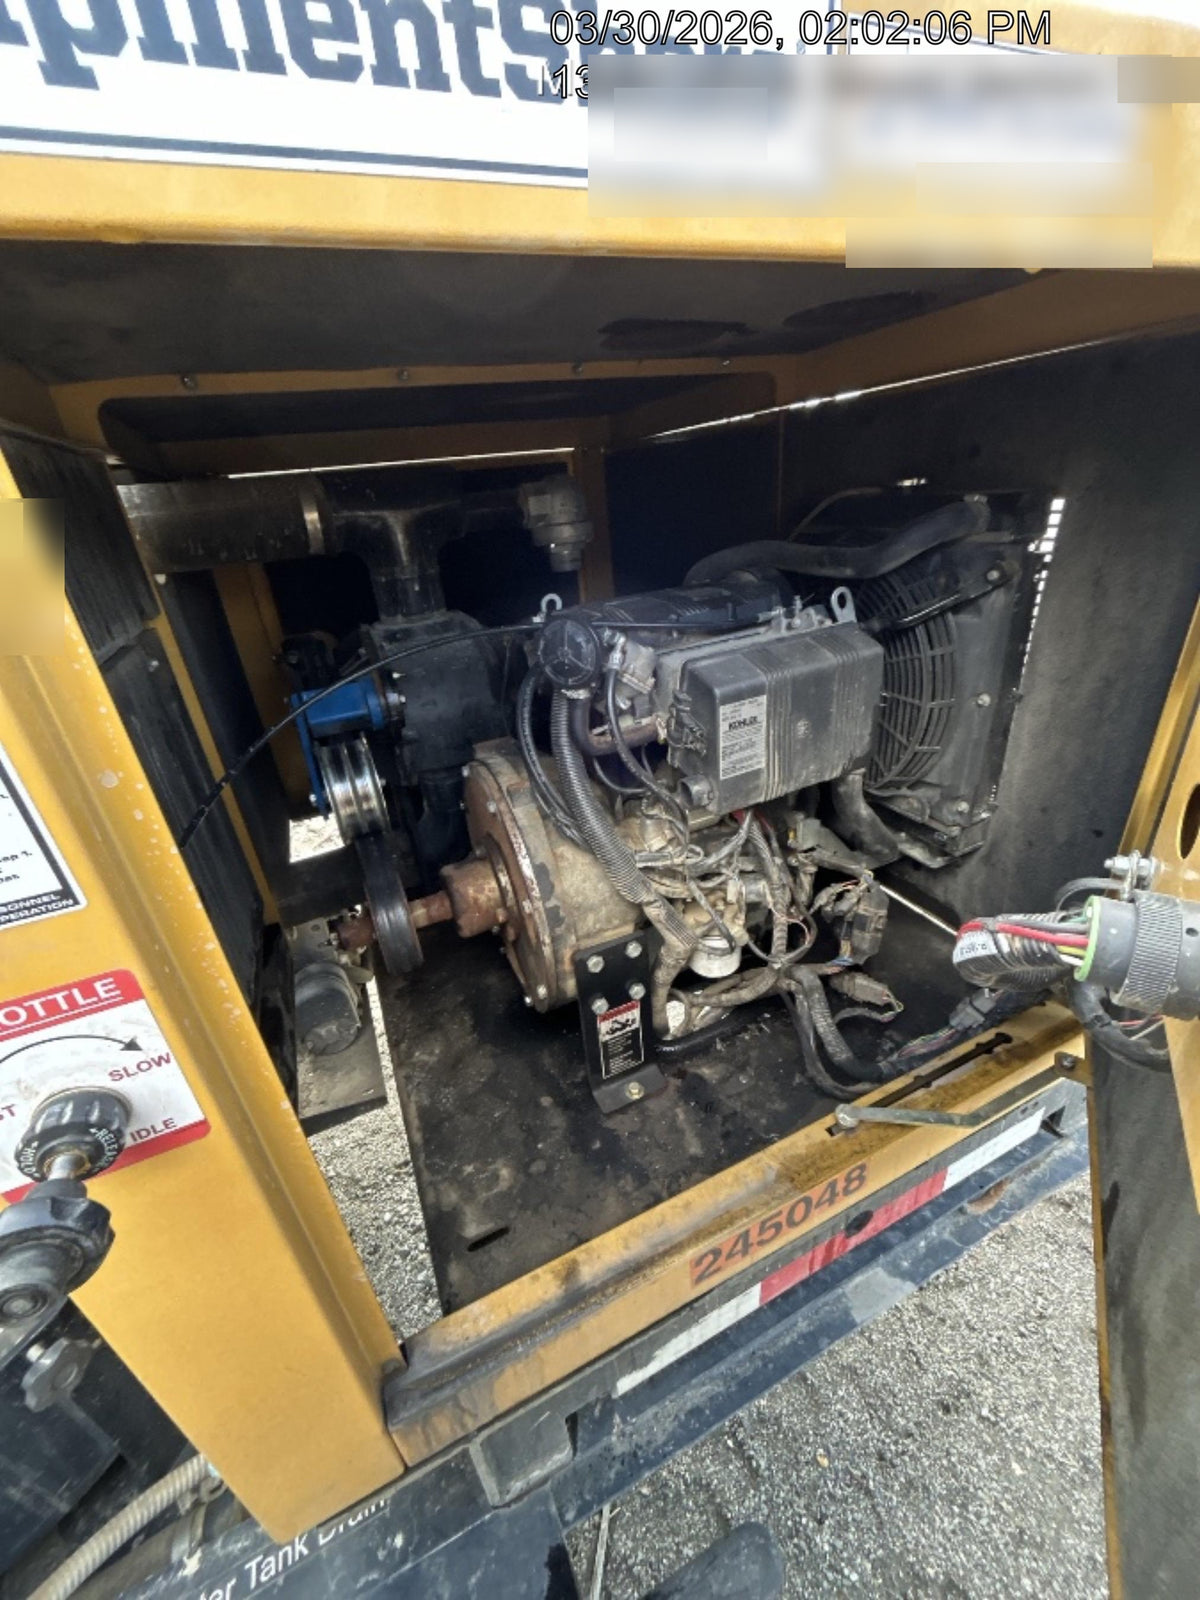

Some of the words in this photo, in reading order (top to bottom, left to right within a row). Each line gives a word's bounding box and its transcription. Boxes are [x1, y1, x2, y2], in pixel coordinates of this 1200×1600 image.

[0, 977, 122, 1031] OTTLE
[108, 1052, 172, 1081] SLOW
[130, 1118, 177, 1142] IDLE
[694, 1163, 867, 1285] 245048
[244, 1532, 309, 1590] Tank
